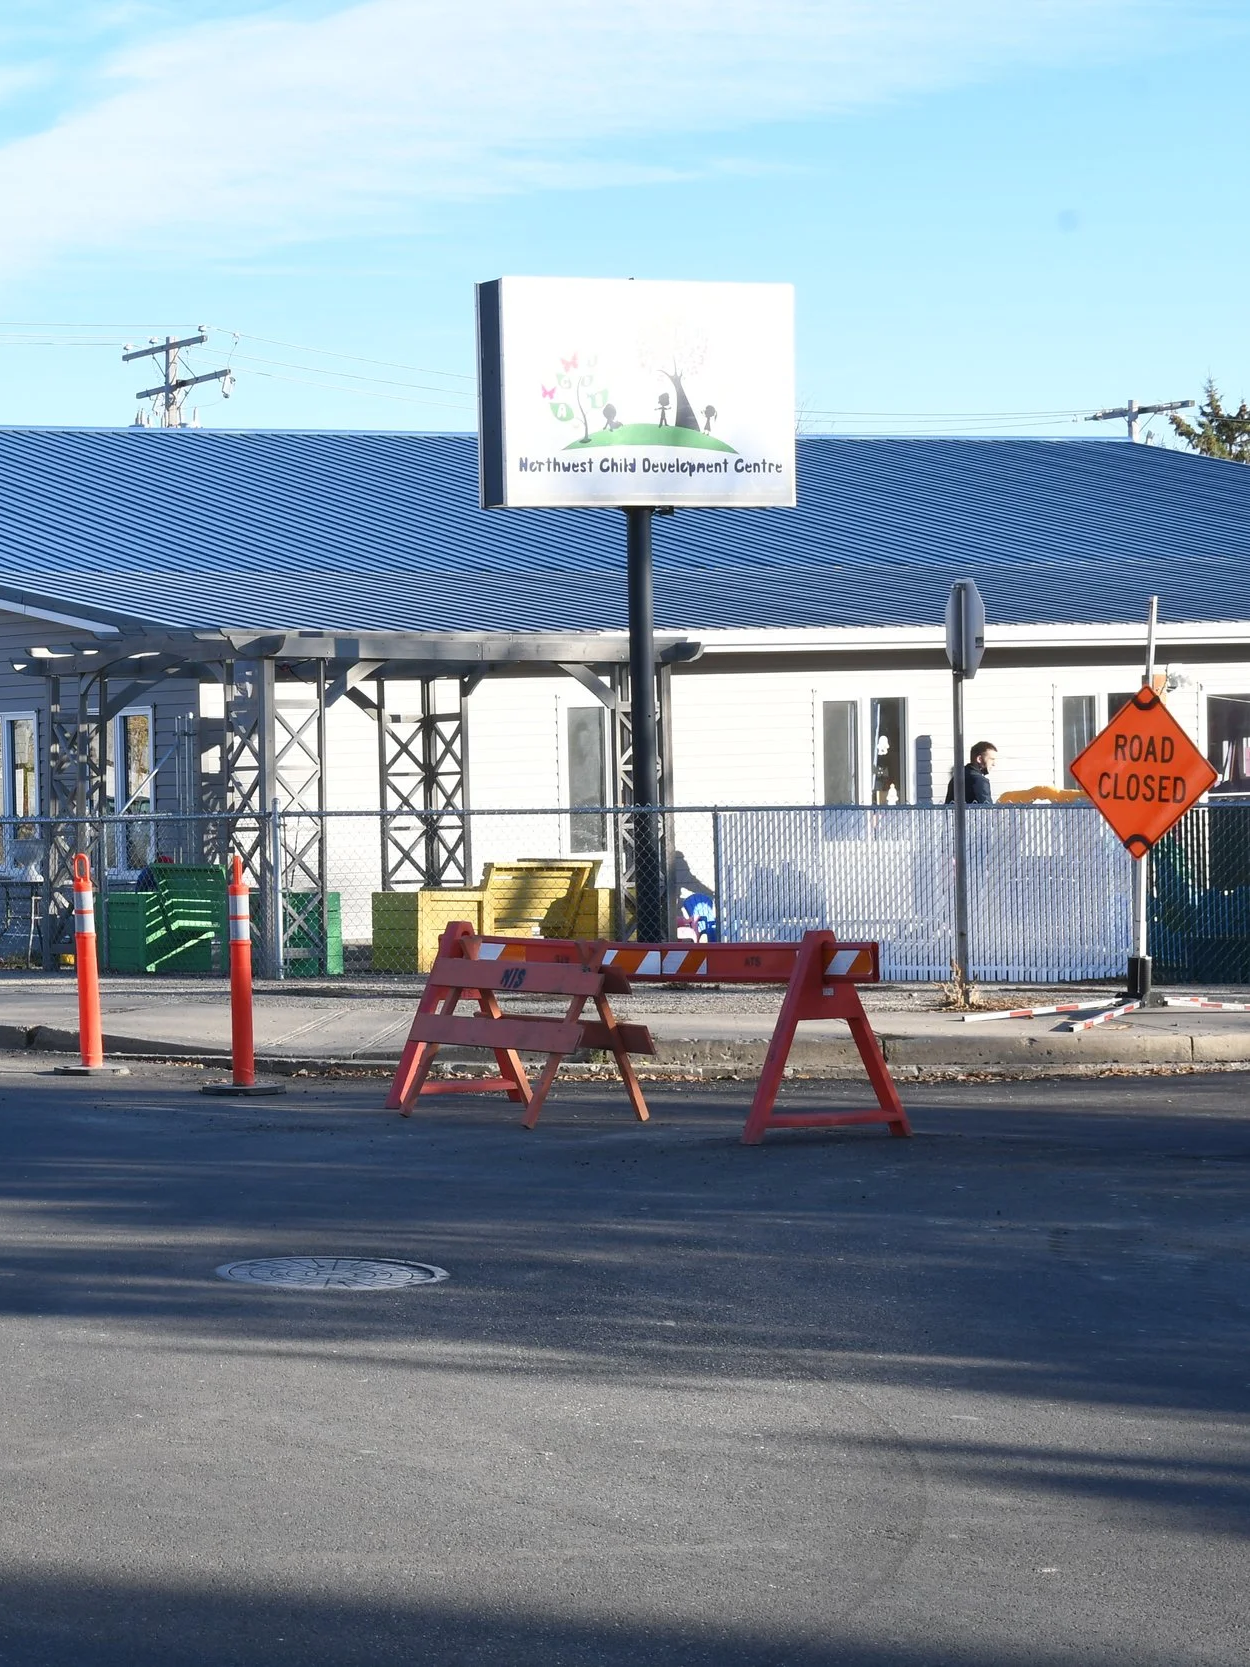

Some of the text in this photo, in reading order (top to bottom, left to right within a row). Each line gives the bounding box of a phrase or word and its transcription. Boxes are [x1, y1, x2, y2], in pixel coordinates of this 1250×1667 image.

[519, 457, 783, 477] Northwest Child Development Centre
[1114, 734, 1174, 763] ROAD
[1098, 772, 1186, 803] CLOSED
[500, 968, 526, 989] NIS
